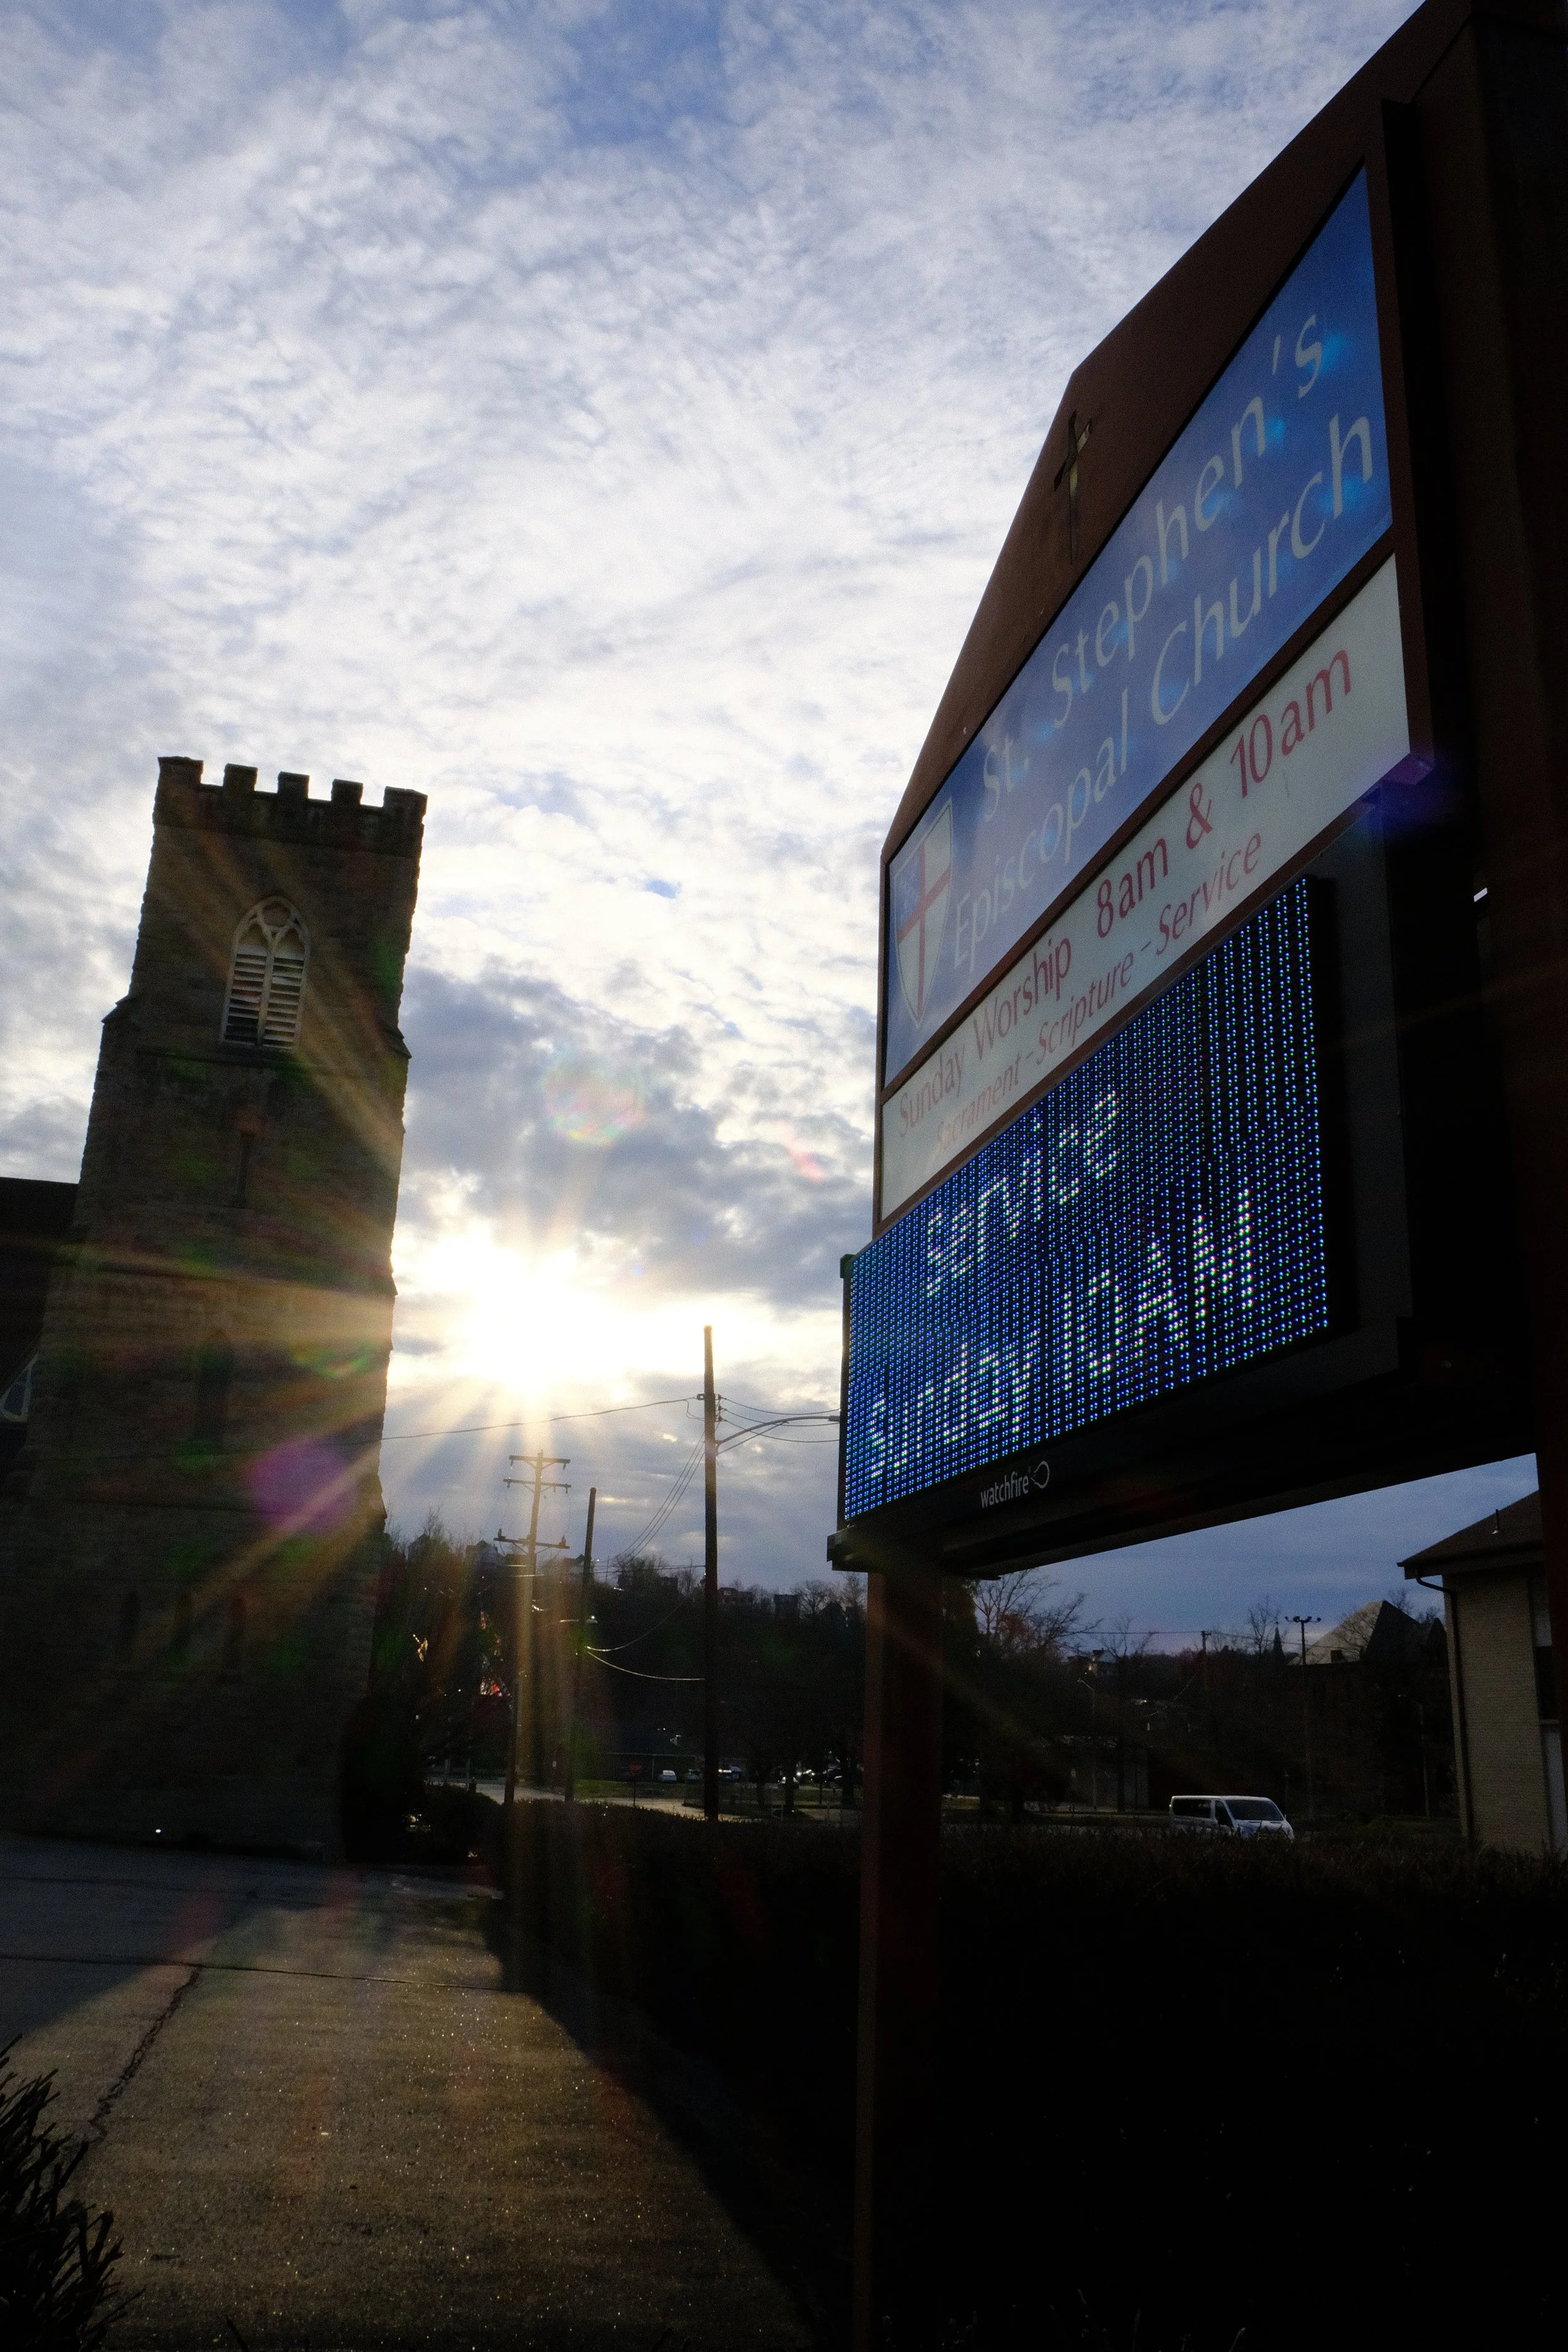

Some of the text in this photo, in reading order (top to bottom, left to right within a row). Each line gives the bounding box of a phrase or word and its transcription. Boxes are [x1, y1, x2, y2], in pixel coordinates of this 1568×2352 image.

[953, 413, 1373, 974] Episcopal Church
[983, 313, 1322, 822] St. Stephen's
[899, 649, 1352, 1137] Sunday Worship 8am & 10am
[1036, 952, 1135, 1066] Scripture
[1155, 833, 1262, 955] Service
[869, 1177, 1255, 1479] Sunday 10AM
[926, 1089, 1120, 1298] Service
[980, 1471, 1029, 1508] watchfire
